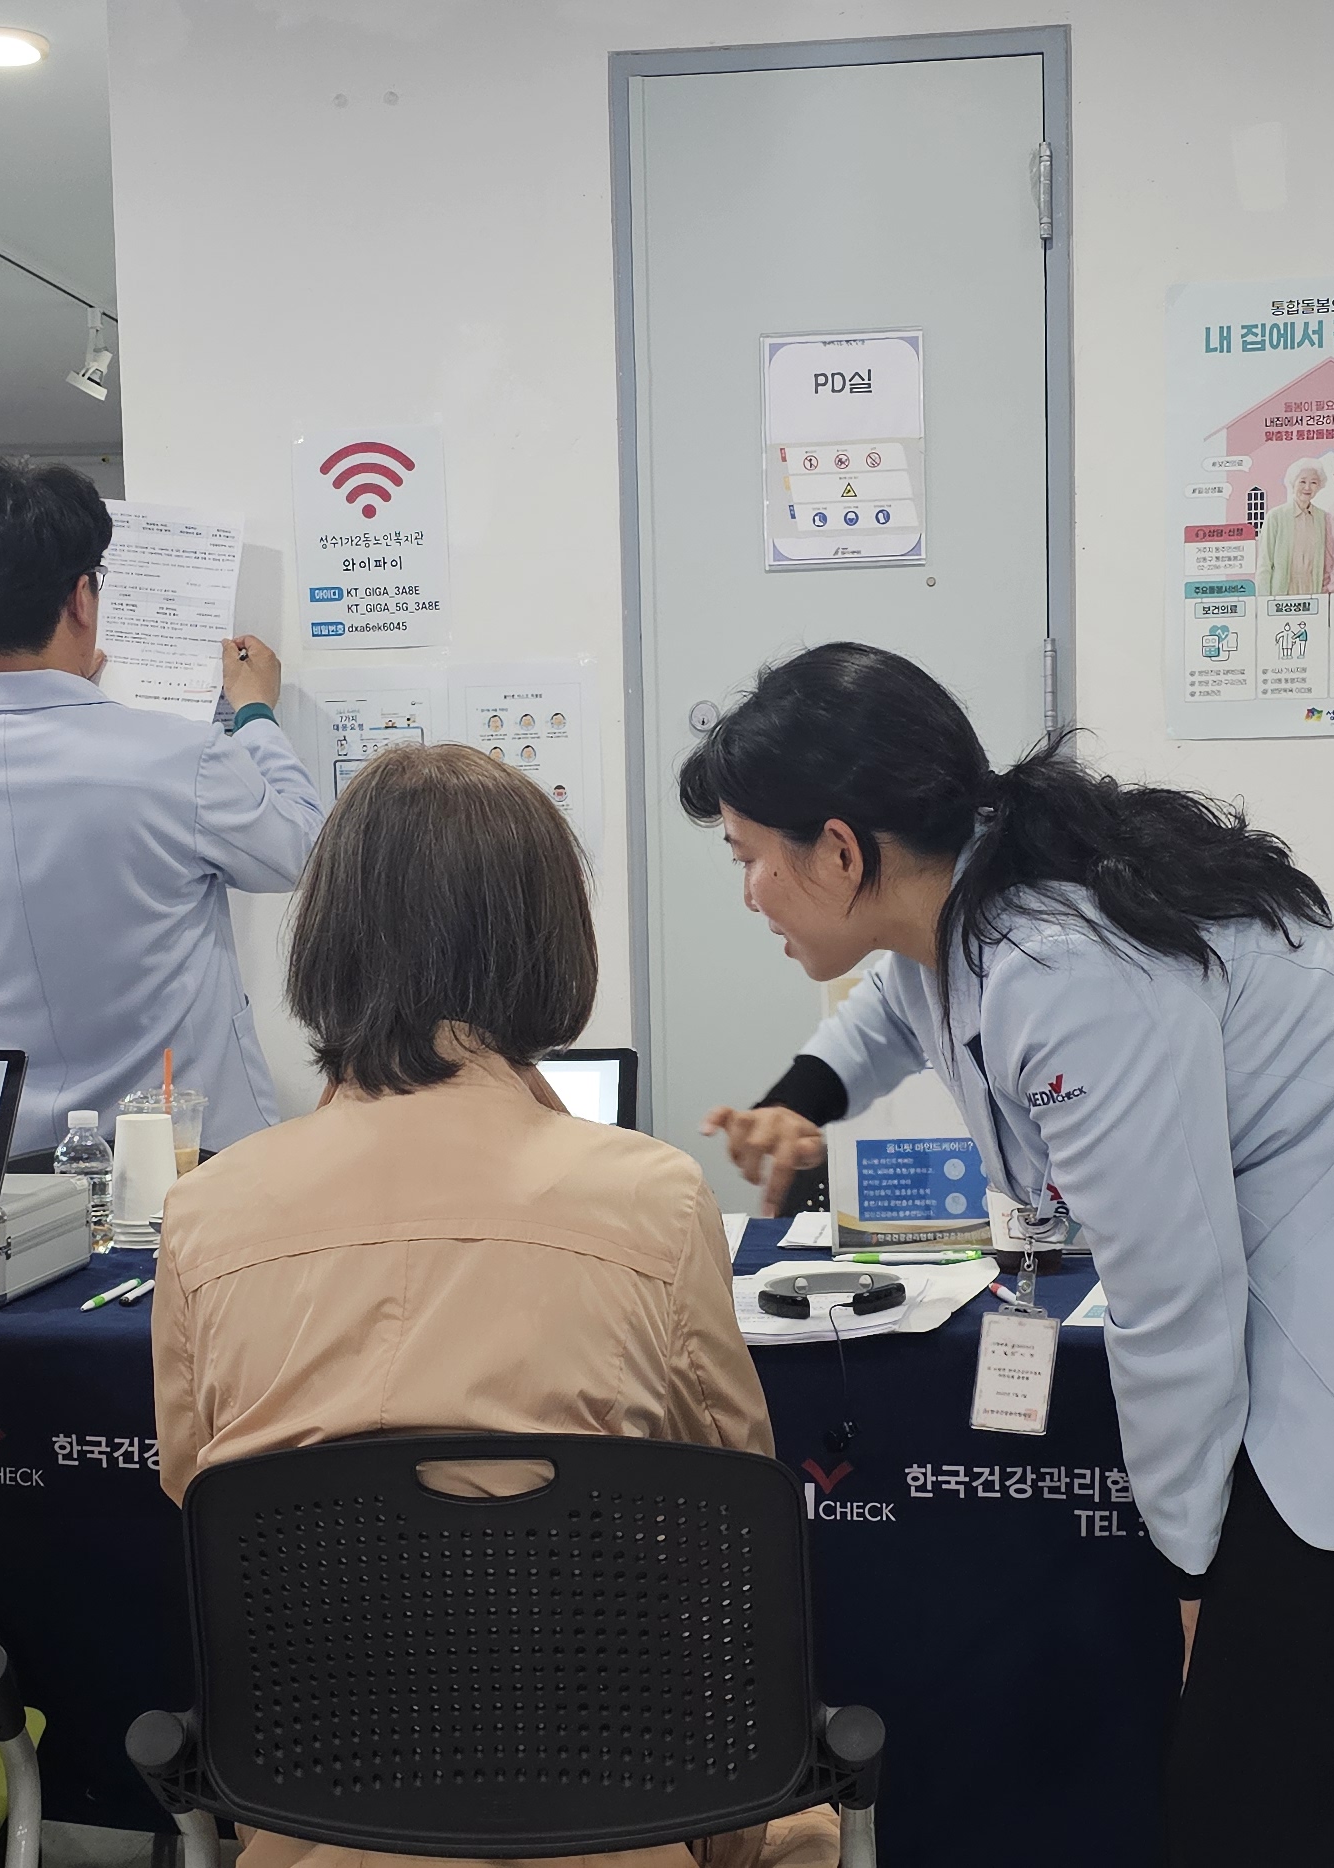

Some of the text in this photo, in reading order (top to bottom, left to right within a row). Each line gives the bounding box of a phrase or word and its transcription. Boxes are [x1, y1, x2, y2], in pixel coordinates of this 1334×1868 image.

[1204, 325, 1232, 353] 내
[1240, 320, 1324, 352] 집에서
[814, 369, 872, 394] PD실
[1264, 415, 1303, 428] 내집에서
[1264, 430, 1294, 442] 맞춤형
[319, 531, 424, 549] 성수1가2동노인복지관
[342, 556, 403, 572] 와이파이
[346, 586, 421, 599] KT_GIGA_3A8E
[347, 601, 441, 615] KT_GIGA_5G_3A8E
[1202, 605, 1238, 615] 보건의료
[347, 622, 408, 634] dxa6ek6045
[1074, 1509, 1127, 1537] TEL
